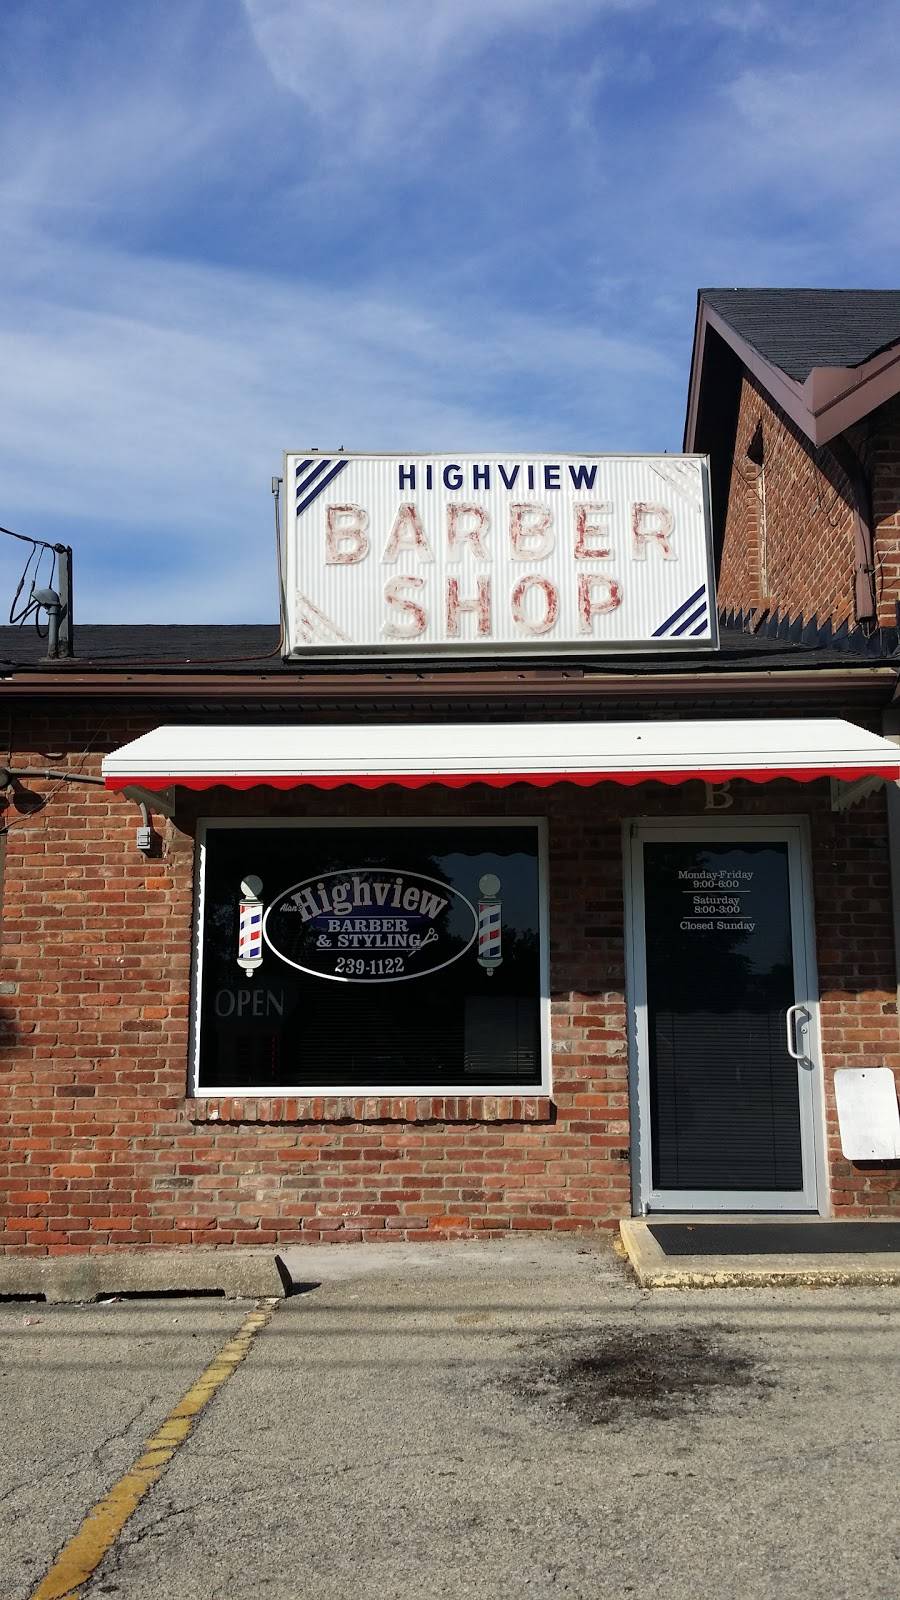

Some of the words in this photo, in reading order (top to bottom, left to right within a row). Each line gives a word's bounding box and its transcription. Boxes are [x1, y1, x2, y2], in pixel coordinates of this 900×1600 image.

[399, 464, 598, 490] HIGHVIEW
[325, 501, 678, 566] BARBER
[380, 572, 624, 639] SHOP
[704, 781, 734, 809] B
[678, 870, 753, 880] Monday-Friday
[693, 880, 739, 888] 9:00-6:00
[291, 876, 449, 923] Highview
[693, 896, 740, 905] Saturday
[328, 919, 409, 932] BARBER
[680, 921, 714, 930] Closed
[717, 921, 755, 931] Sunday
[316, 934, 332, 947] &
[337, 934, 421, 947] STYLING
[335, 957, 404, 974] 239-1122
[215, 989, 284, 1016] OPEN
